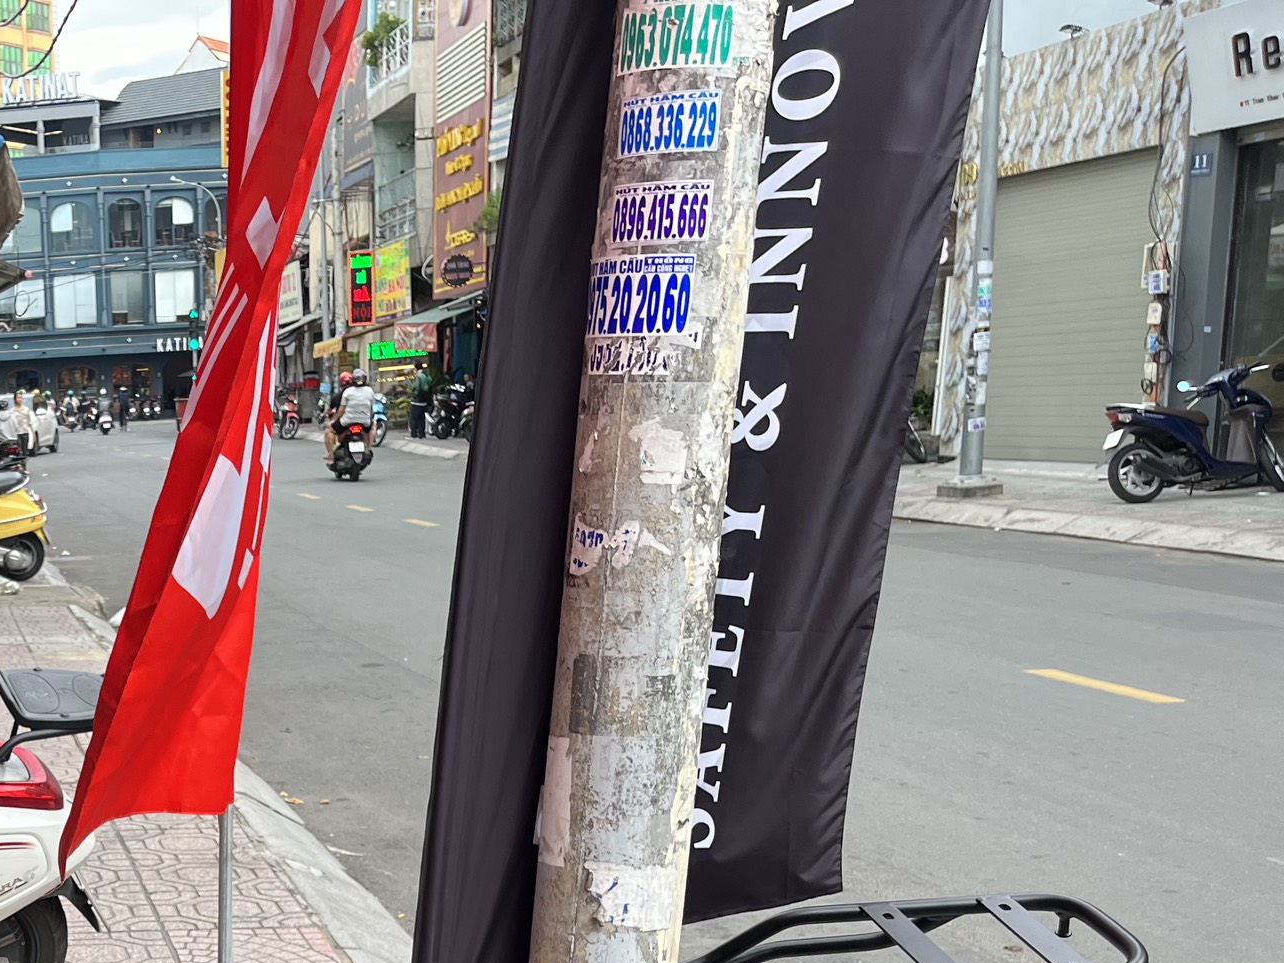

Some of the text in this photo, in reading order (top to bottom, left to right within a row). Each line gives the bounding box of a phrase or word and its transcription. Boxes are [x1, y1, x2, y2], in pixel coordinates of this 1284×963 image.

[2, 71, 81, 105] KATINAT
[620, 101, 717, 156] 0868.336.229
[1194, 154, 1208, 169] 11
[612, 192, 709, 243] 0896.415.666
